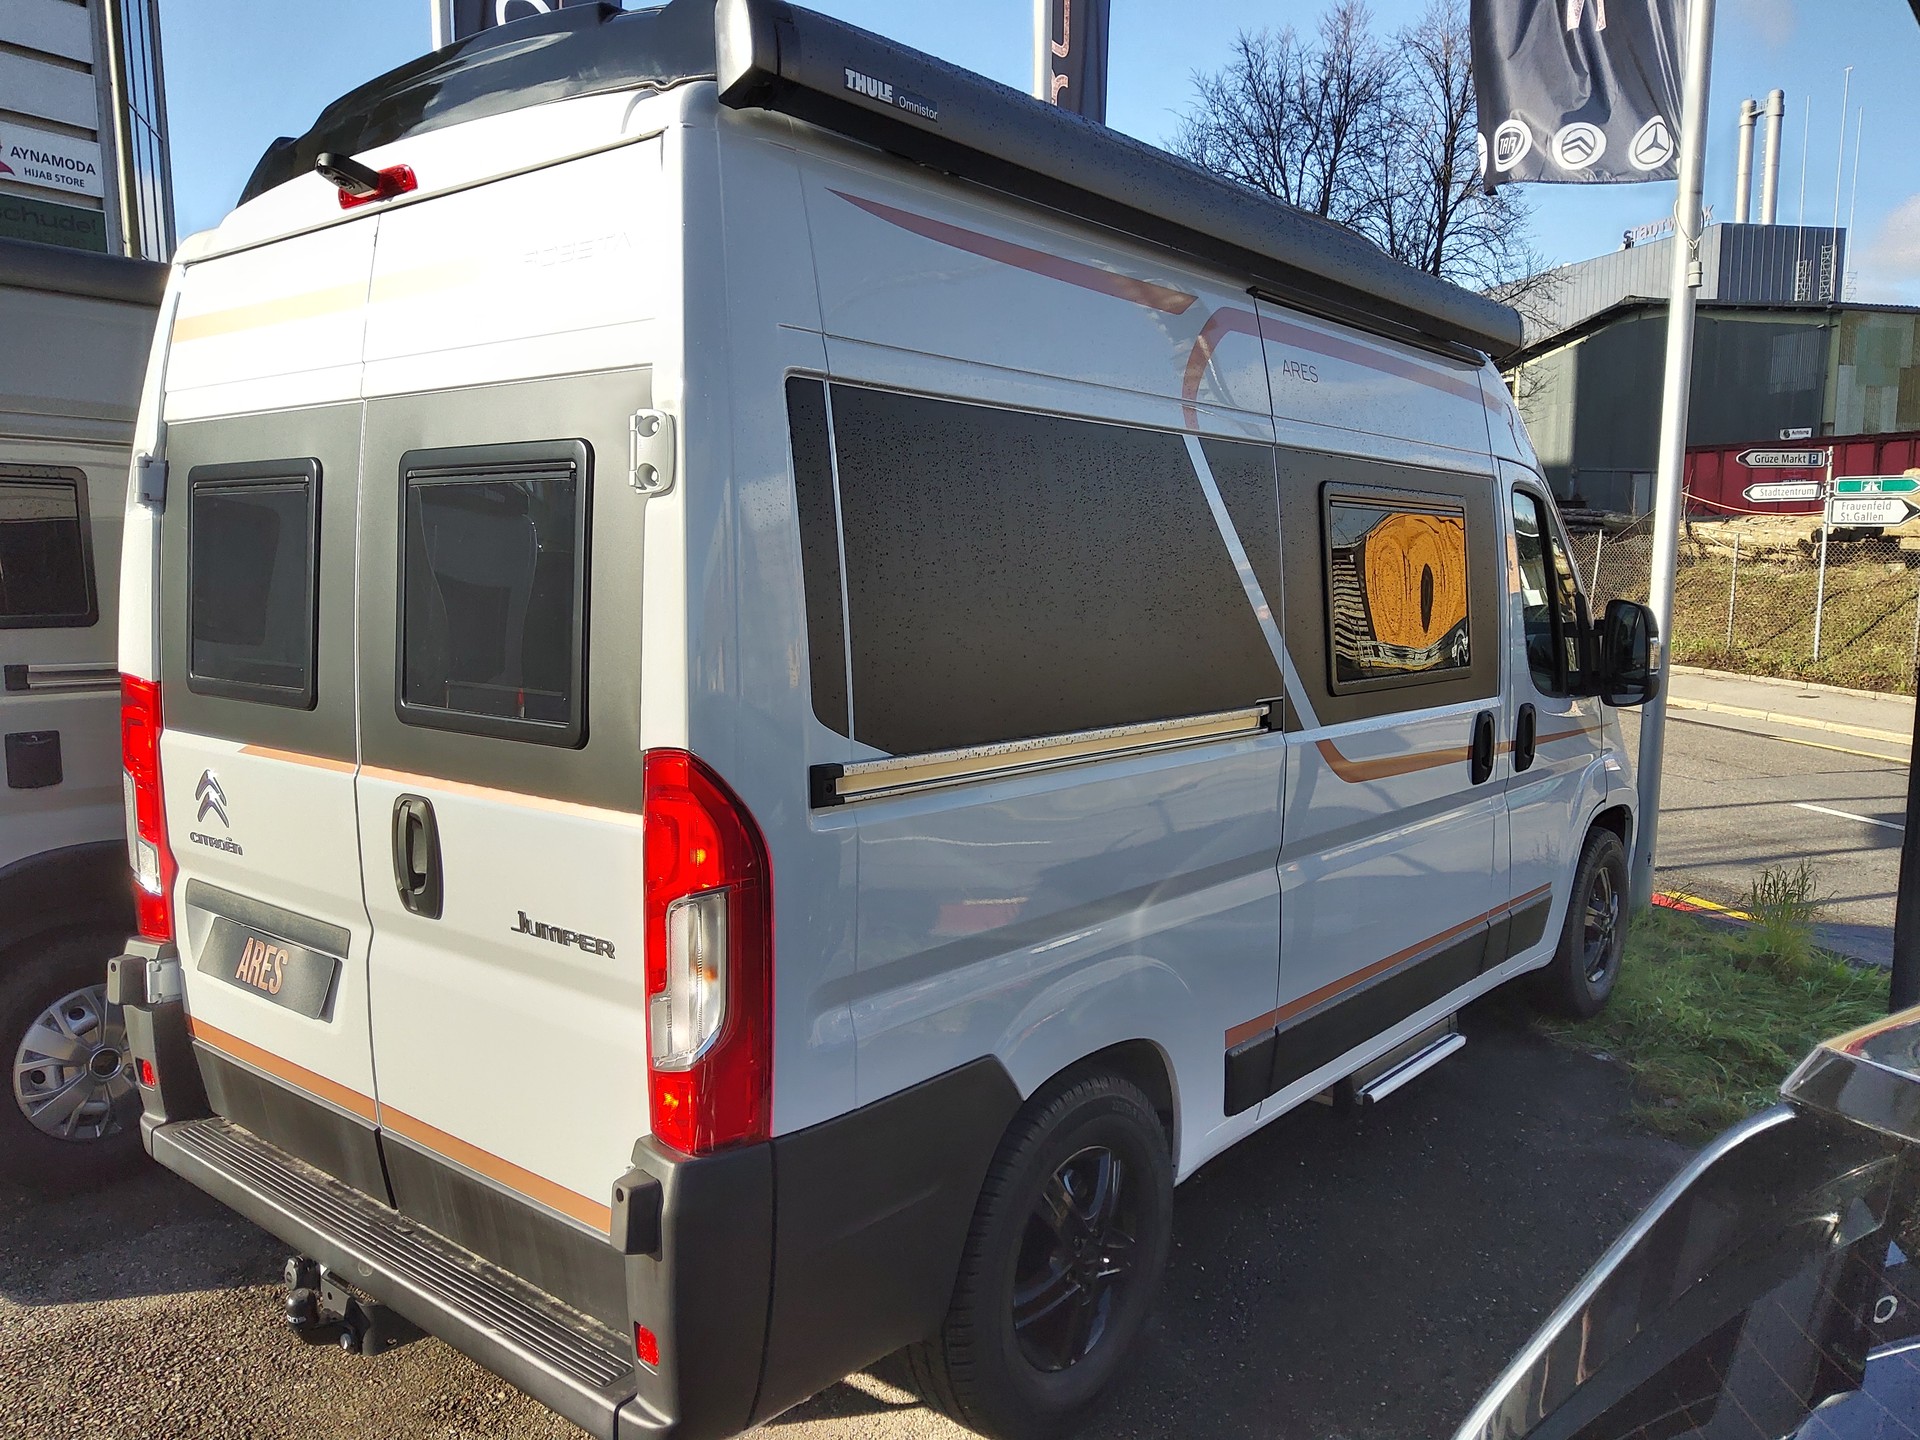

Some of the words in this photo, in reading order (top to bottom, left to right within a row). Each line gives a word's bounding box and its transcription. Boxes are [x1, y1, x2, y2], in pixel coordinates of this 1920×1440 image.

[845, 68, 893, 104] THULE
[899, 95, 938, 120] Omnistor
[10, 146, 96, 176] AYNAMODA
[24, 167, 53, 181] HIJAB
[55, 173, 85, 188] STORE
[0, 204, 97, 235] chudel
[1282, 359, 1319, 384] ARES
[1754, 452, 1779, 464] Grüze
[1781, 452, 1806, 464] Markt
[1760, 486, 1814, 497] Stadtzentrum
[1841, 500, 1892, 511] Frauenfeld
[235, 936, 289, 995] ARES
